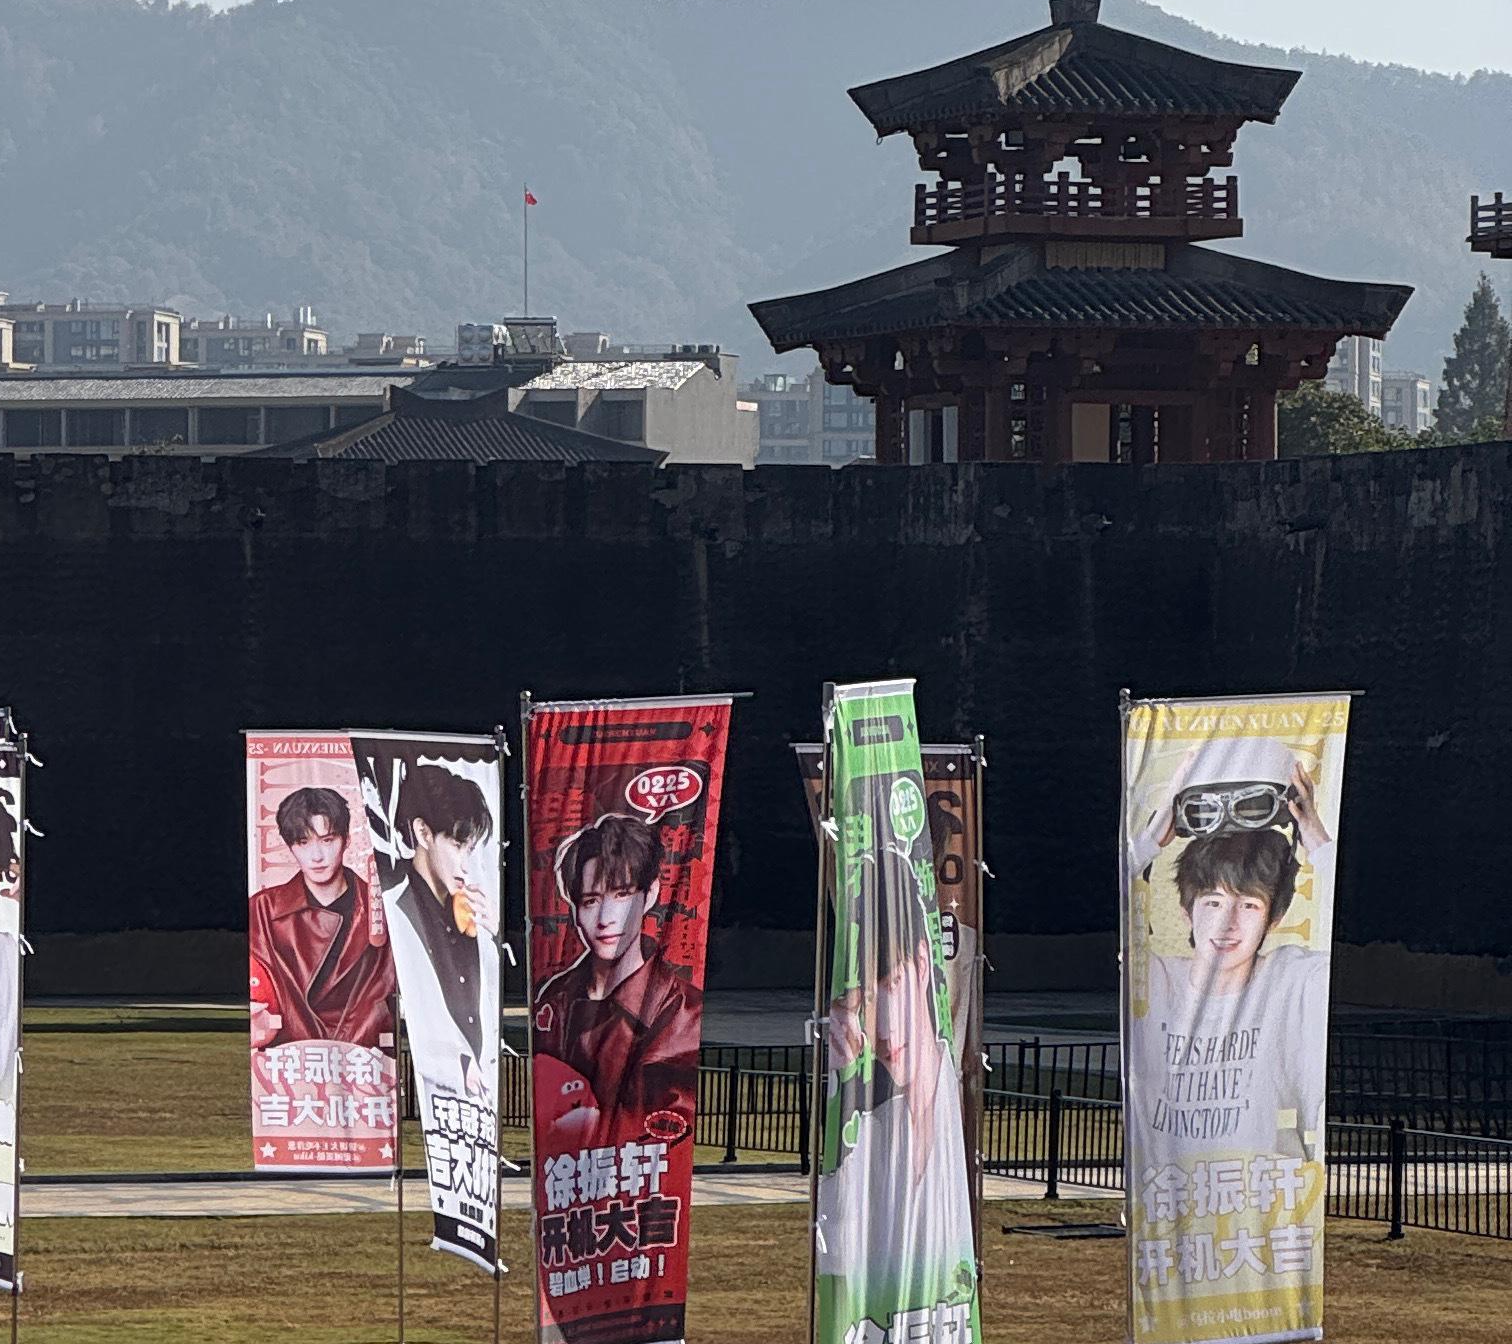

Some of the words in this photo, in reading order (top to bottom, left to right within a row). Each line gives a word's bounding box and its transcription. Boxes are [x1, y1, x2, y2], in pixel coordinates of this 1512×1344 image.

[637, 771, 690, 795] 0225
[543, 1142, 669, 1211] 徐振轩
[1141, 1155, 1306, 1224] 徐振轩
[541, 1194, 681, 1268] 开机大吉
[1137, 1223, 1315, 1287] 开机大吉
